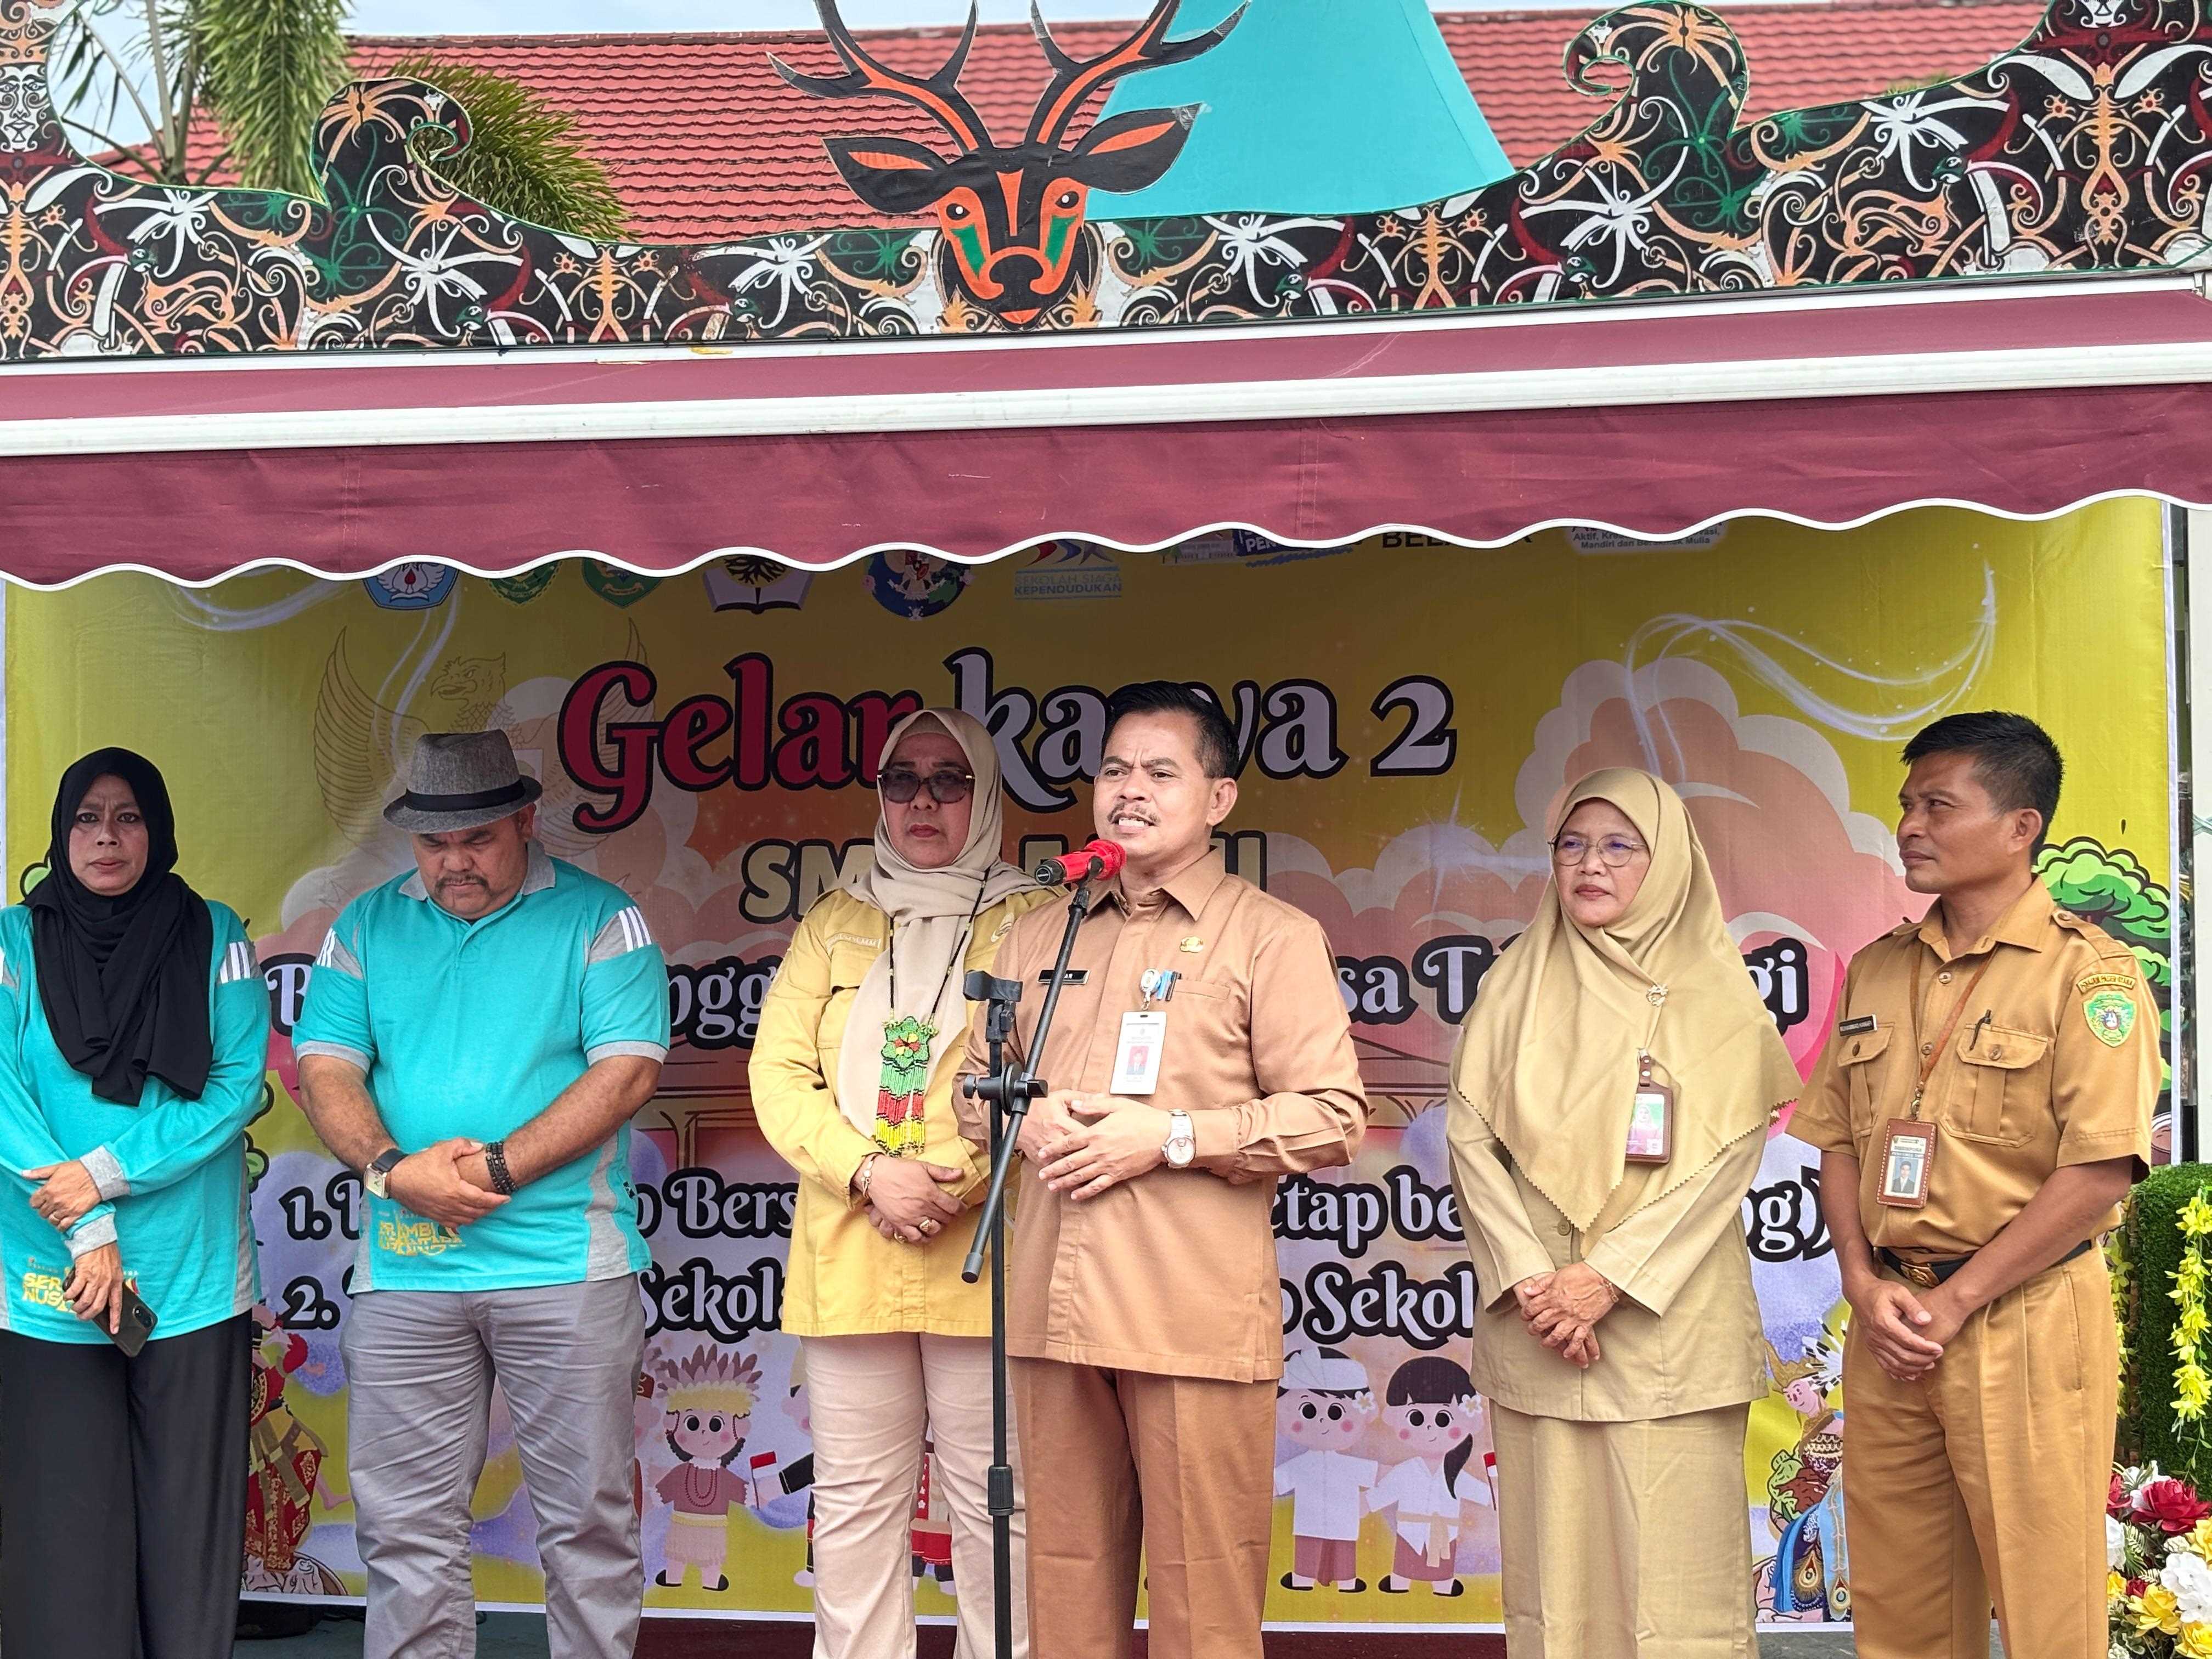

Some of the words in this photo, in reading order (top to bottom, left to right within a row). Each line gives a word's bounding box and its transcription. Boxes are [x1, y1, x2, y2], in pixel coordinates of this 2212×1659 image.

[1015, 574, 1077, 585] SEKOLAH
[1014, 583, 1122, 595] KEPENDUDUKAN
[558, 653, 923, 833] Gelar
[945, 648, 1347, 812] kaa
[1371, 676, 1456, 776] 2
